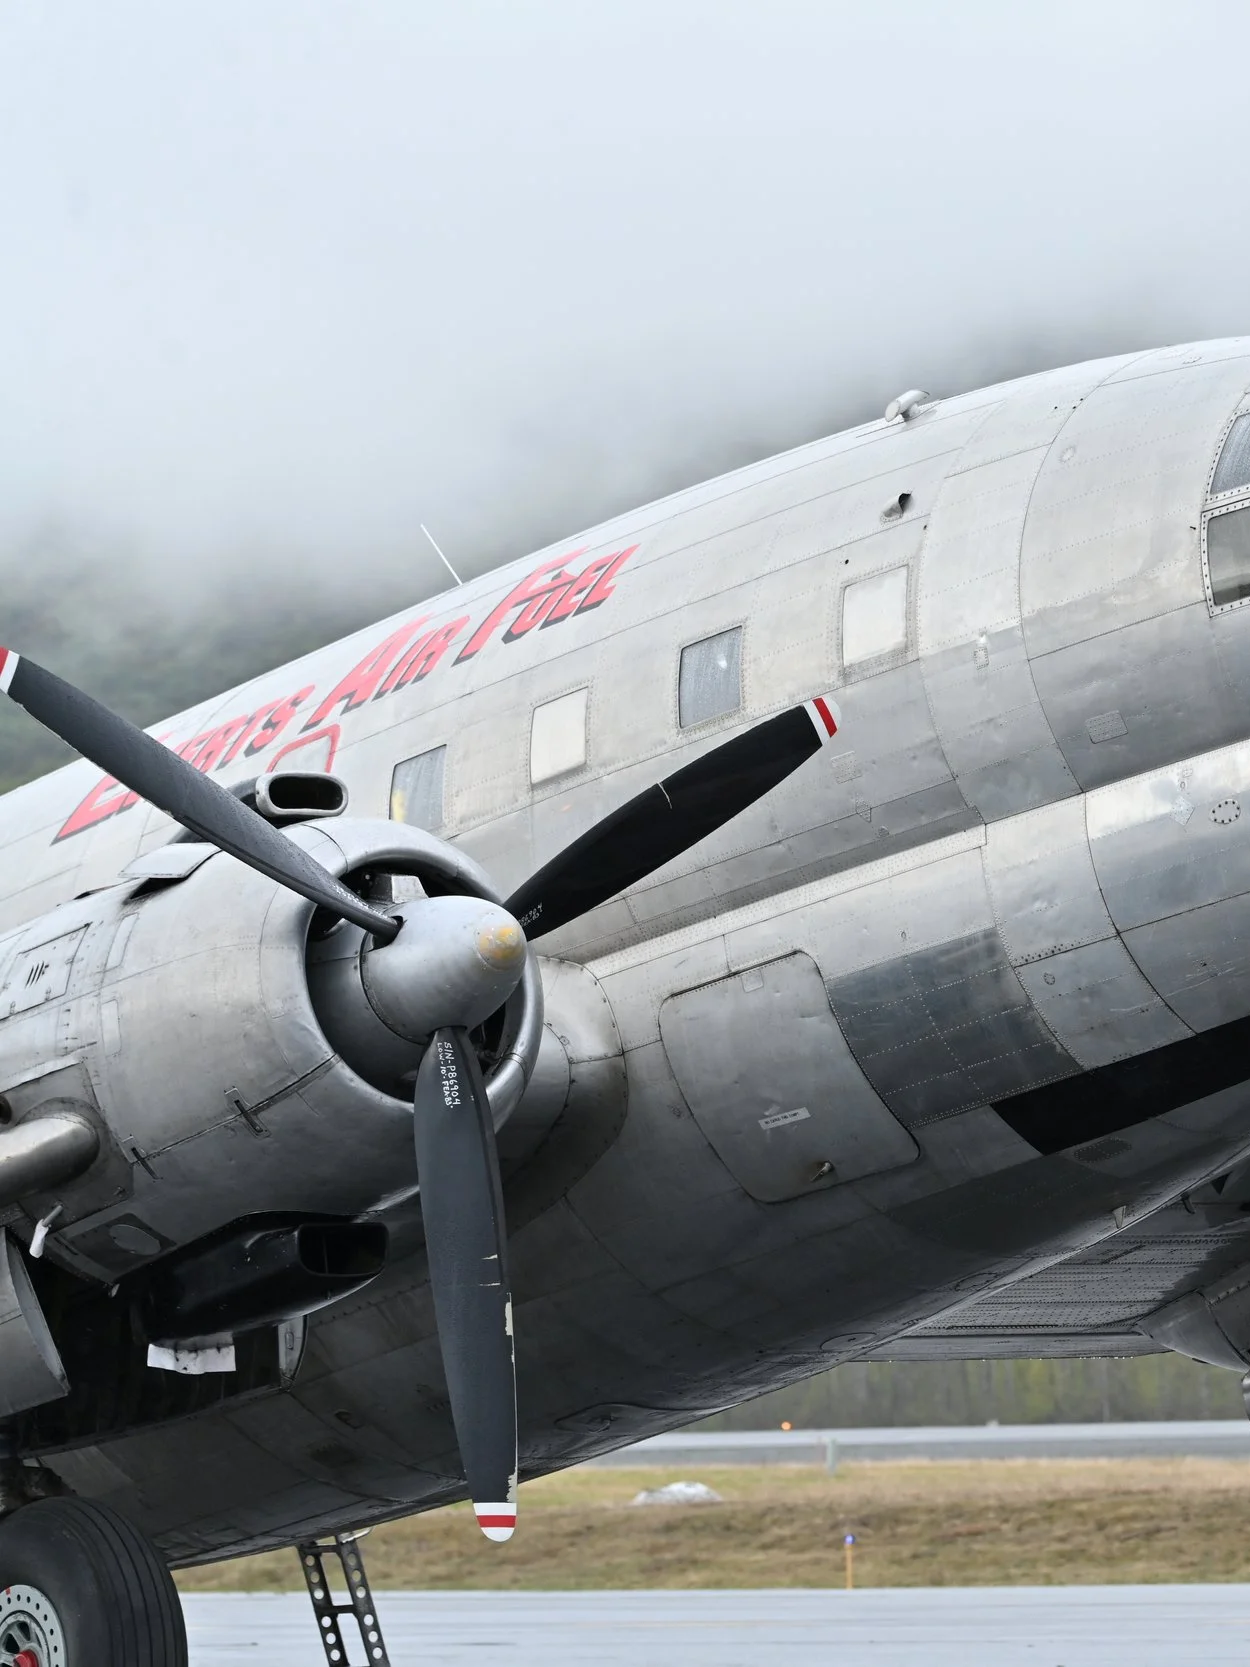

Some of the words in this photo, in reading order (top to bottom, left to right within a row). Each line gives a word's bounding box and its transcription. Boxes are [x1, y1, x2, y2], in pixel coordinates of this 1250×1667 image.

[50, 684, 316, 846] EERTS
[301, 611, 470, 732] AIR
[453, 543, 640, 666] FUEL
